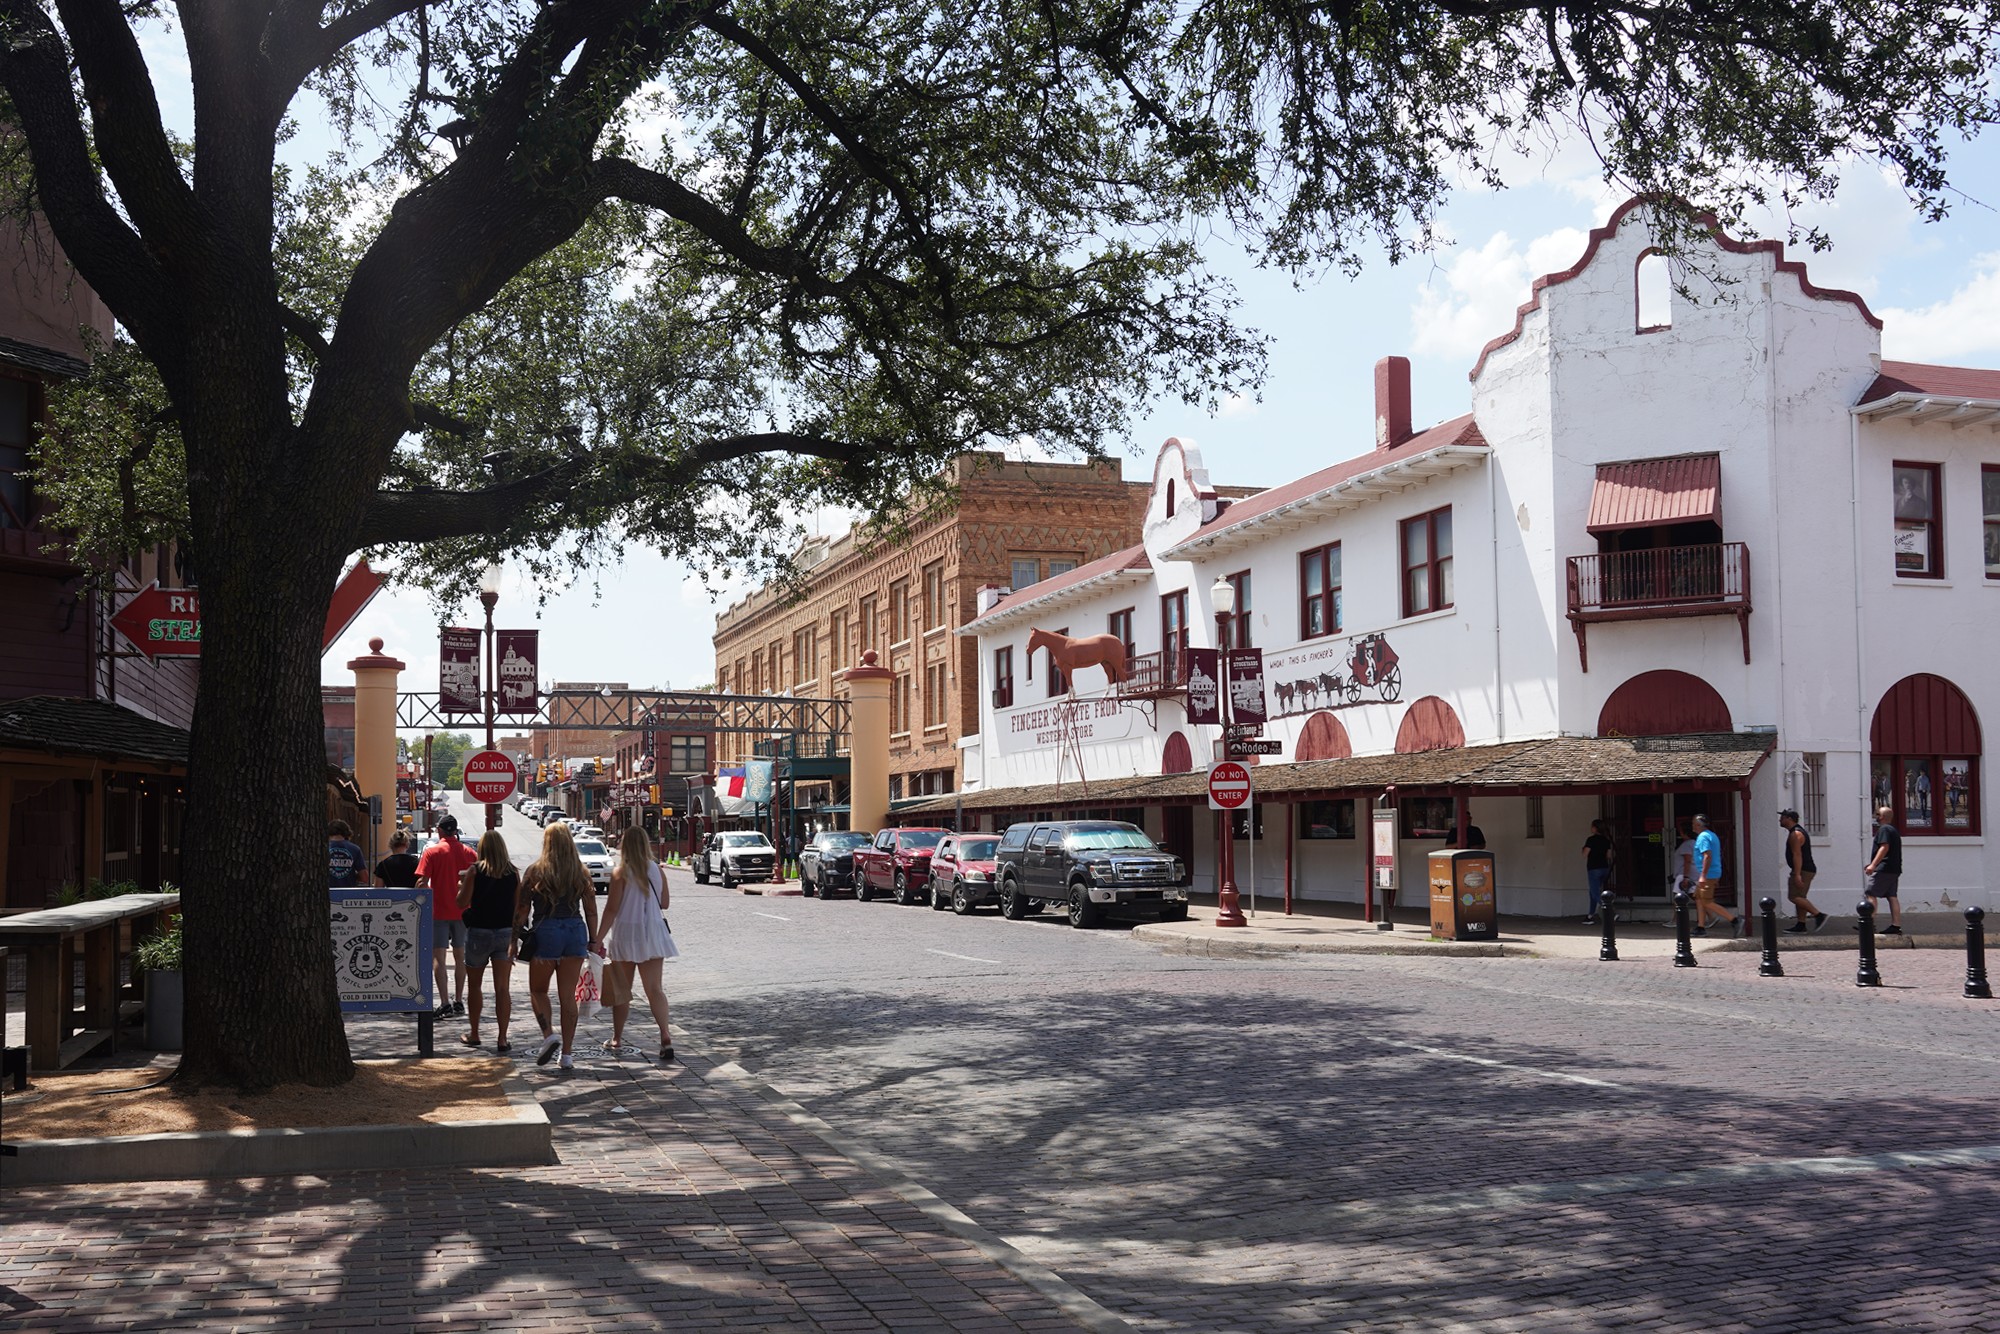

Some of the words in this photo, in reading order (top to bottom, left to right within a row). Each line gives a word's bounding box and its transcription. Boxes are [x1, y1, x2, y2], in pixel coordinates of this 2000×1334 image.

[1288, 656, 1299, 665] THIS
[1301, 654, 1306, 663] IS
[1011, 706, 1058, 733] FINCHER'S
[1094, 700, 1123, 718] FRONT
[1036, 729, 1067, 744] WESTERN
[1070, 724, 1094, 740] STORE
[1237, 726, 1257, 737] Exchange
[1242, 743, 1268, 753] Rodeo
[472, 761, 485, 770] DO
[491, 761, 509, 770] NOT
[476, 784, 505, 793] ENTER
[344, 936, 388, 950] BACKYARD
[342, 976, 361, 988] HOTEL
[364, 975, 389, 988] DROVER
